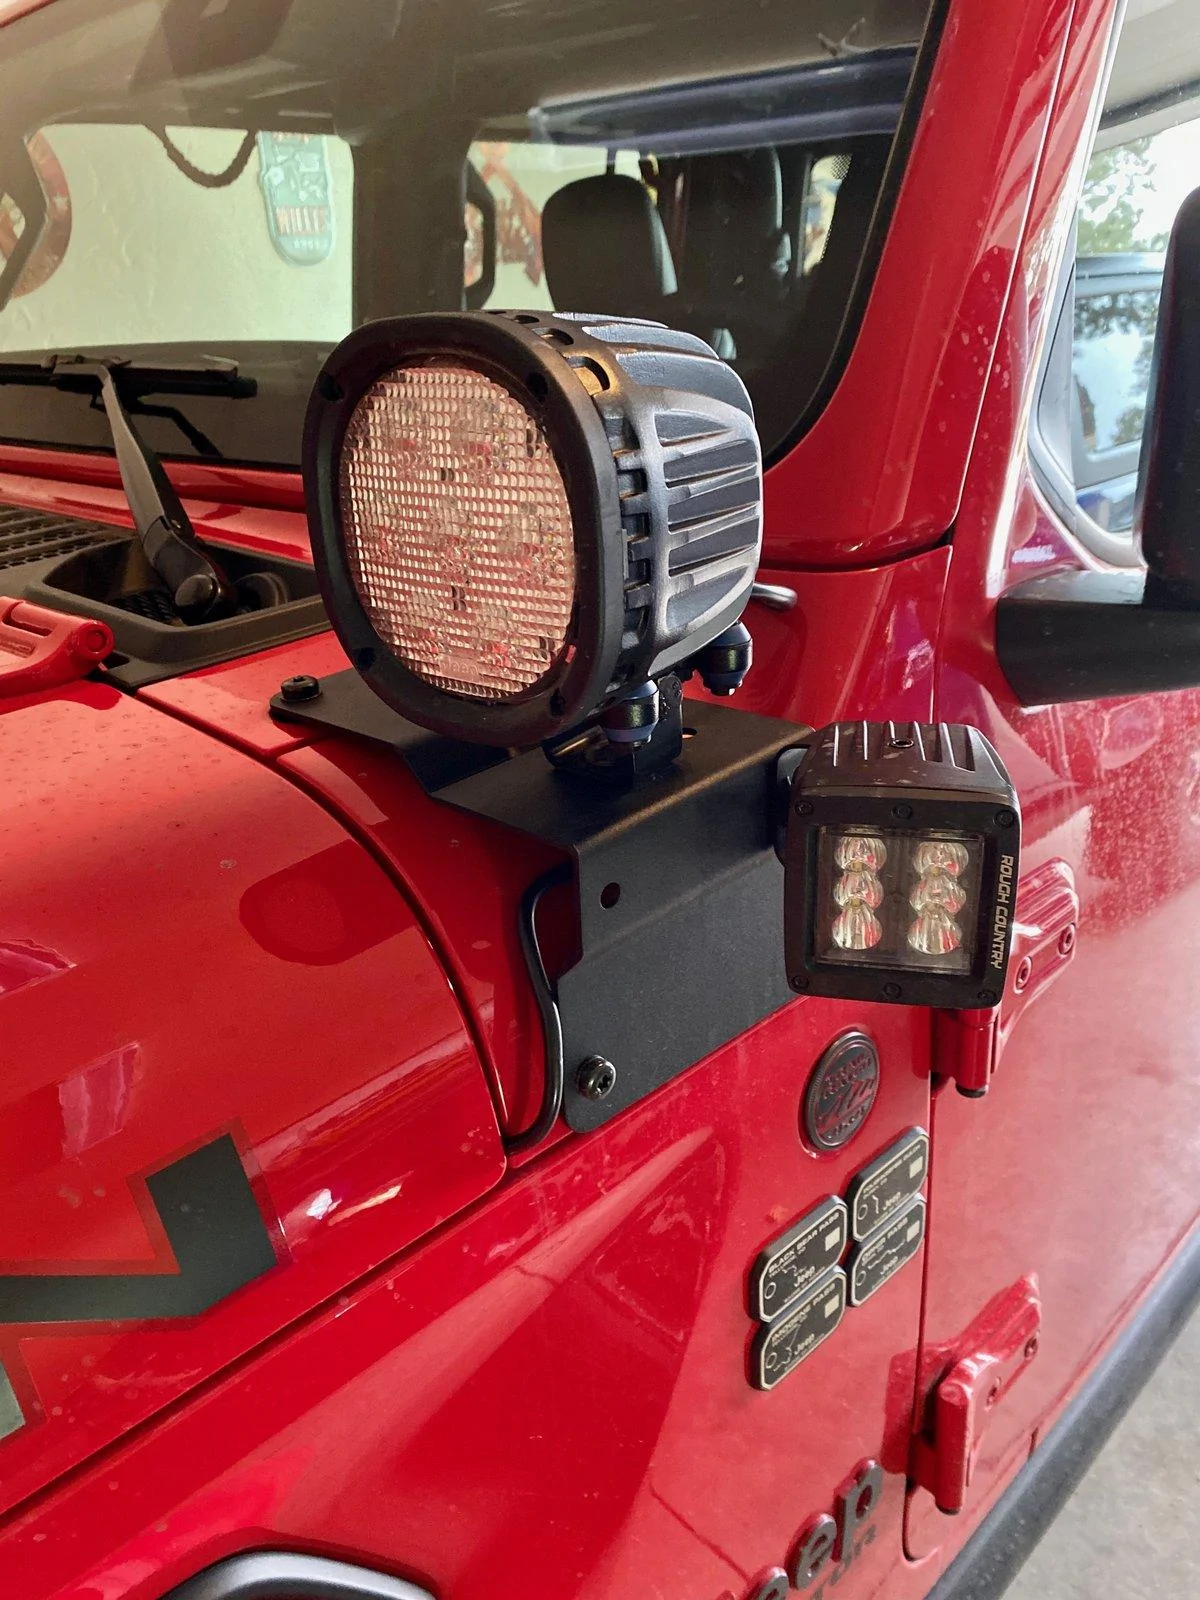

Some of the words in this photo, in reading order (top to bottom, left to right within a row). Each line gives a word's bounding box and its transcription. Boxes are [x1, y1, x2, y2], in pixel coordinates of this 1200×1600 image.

[997, 854, 1014, 904] ROUGH
[990, 905, 1009, 970] COUNTRY
[768, 1248, 795, 1274] BLACK
[796, 1229, 818, 1251] BEAR
[818, 1212, 840, 1232] PASS
[793, 1265, 815, 1287] Jeep
